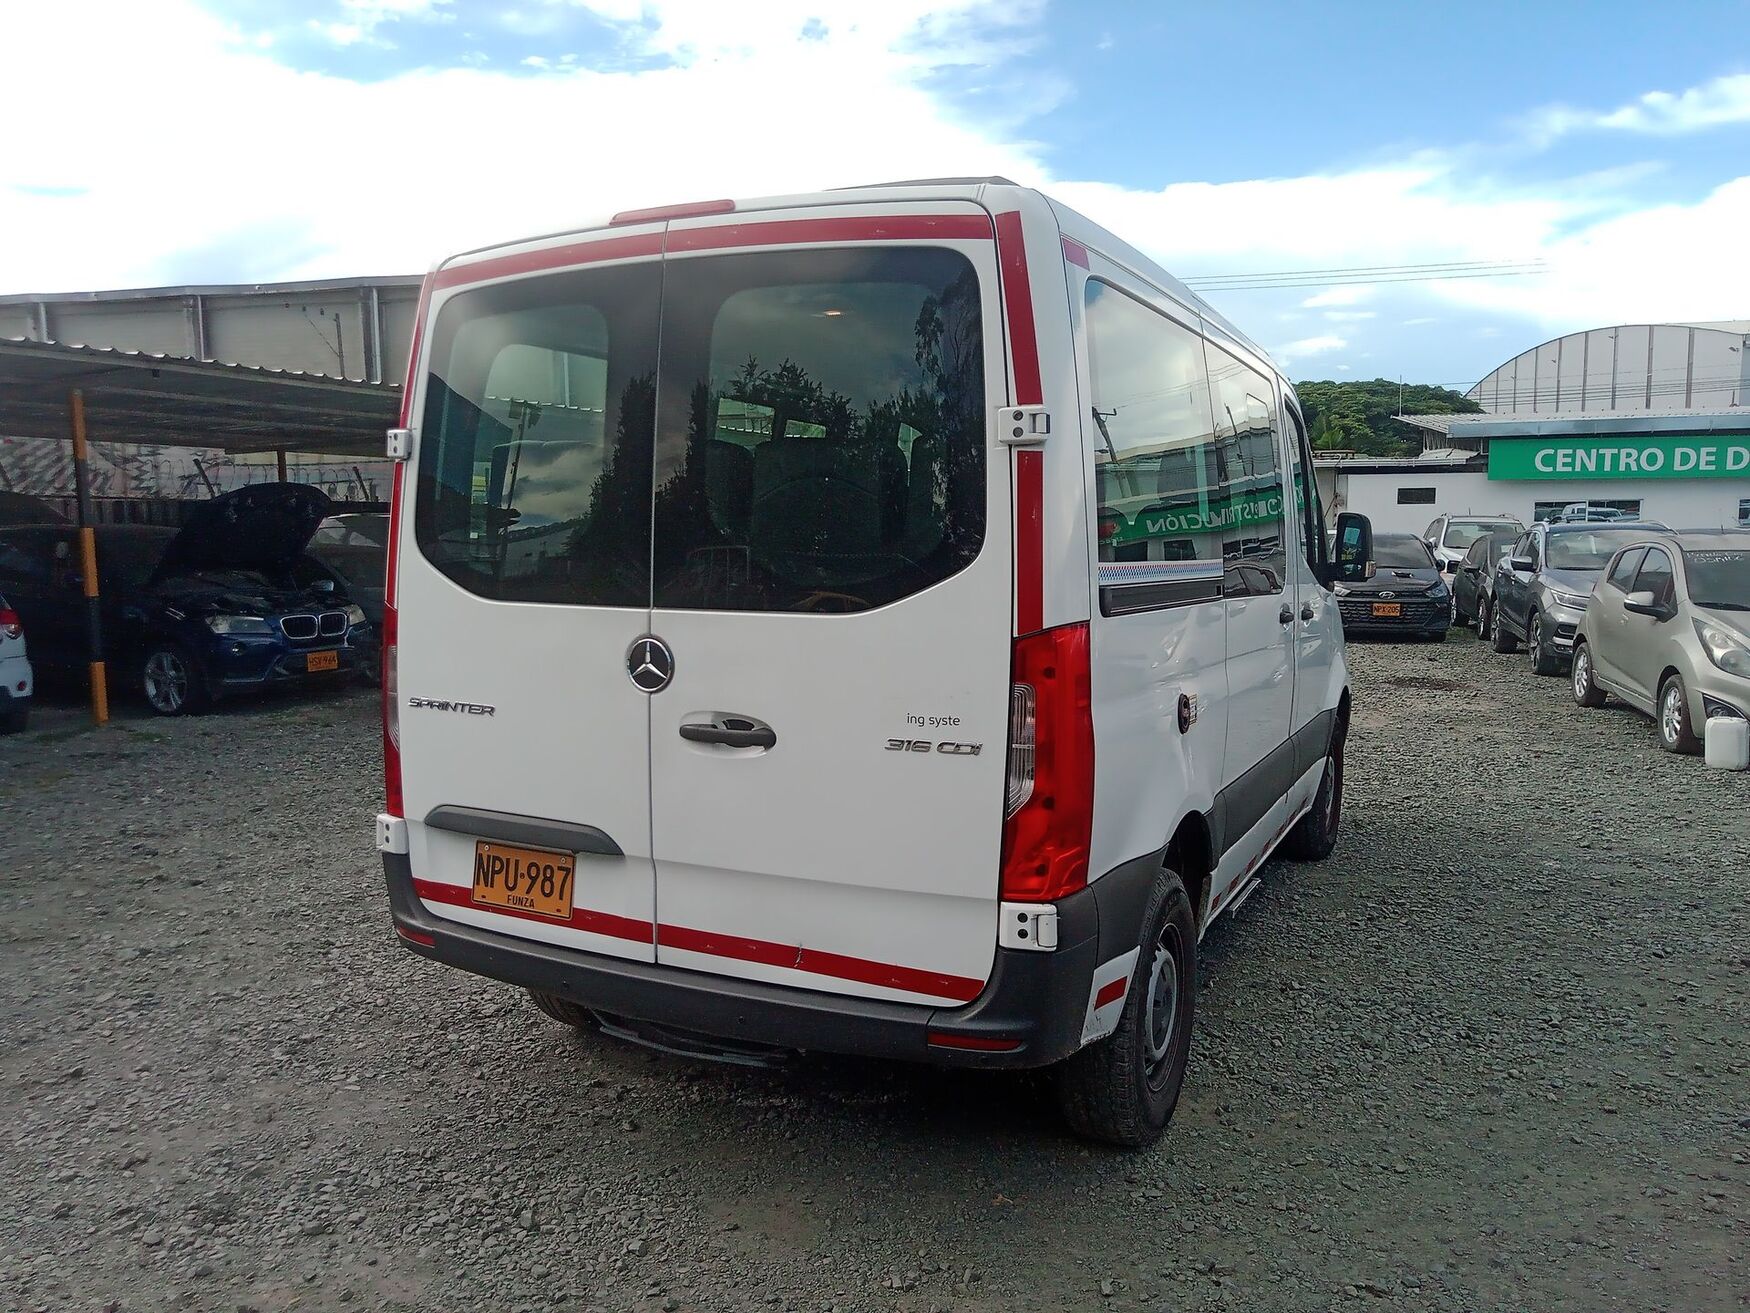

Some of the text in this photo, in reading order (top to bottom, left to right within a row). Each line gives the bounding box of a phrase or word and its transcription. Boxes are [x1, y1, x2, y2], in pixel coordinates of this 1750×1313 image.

[1534, 447, 1665, 472] CENTRO
[1673, 447, 1717, 471] DE
[408, 697, 495, 717] SPRINTER
[907, 713, 961, 728] ing syste
[884, 738, 932, 753] 316
[507, 895, 535, 909] FUNZA
